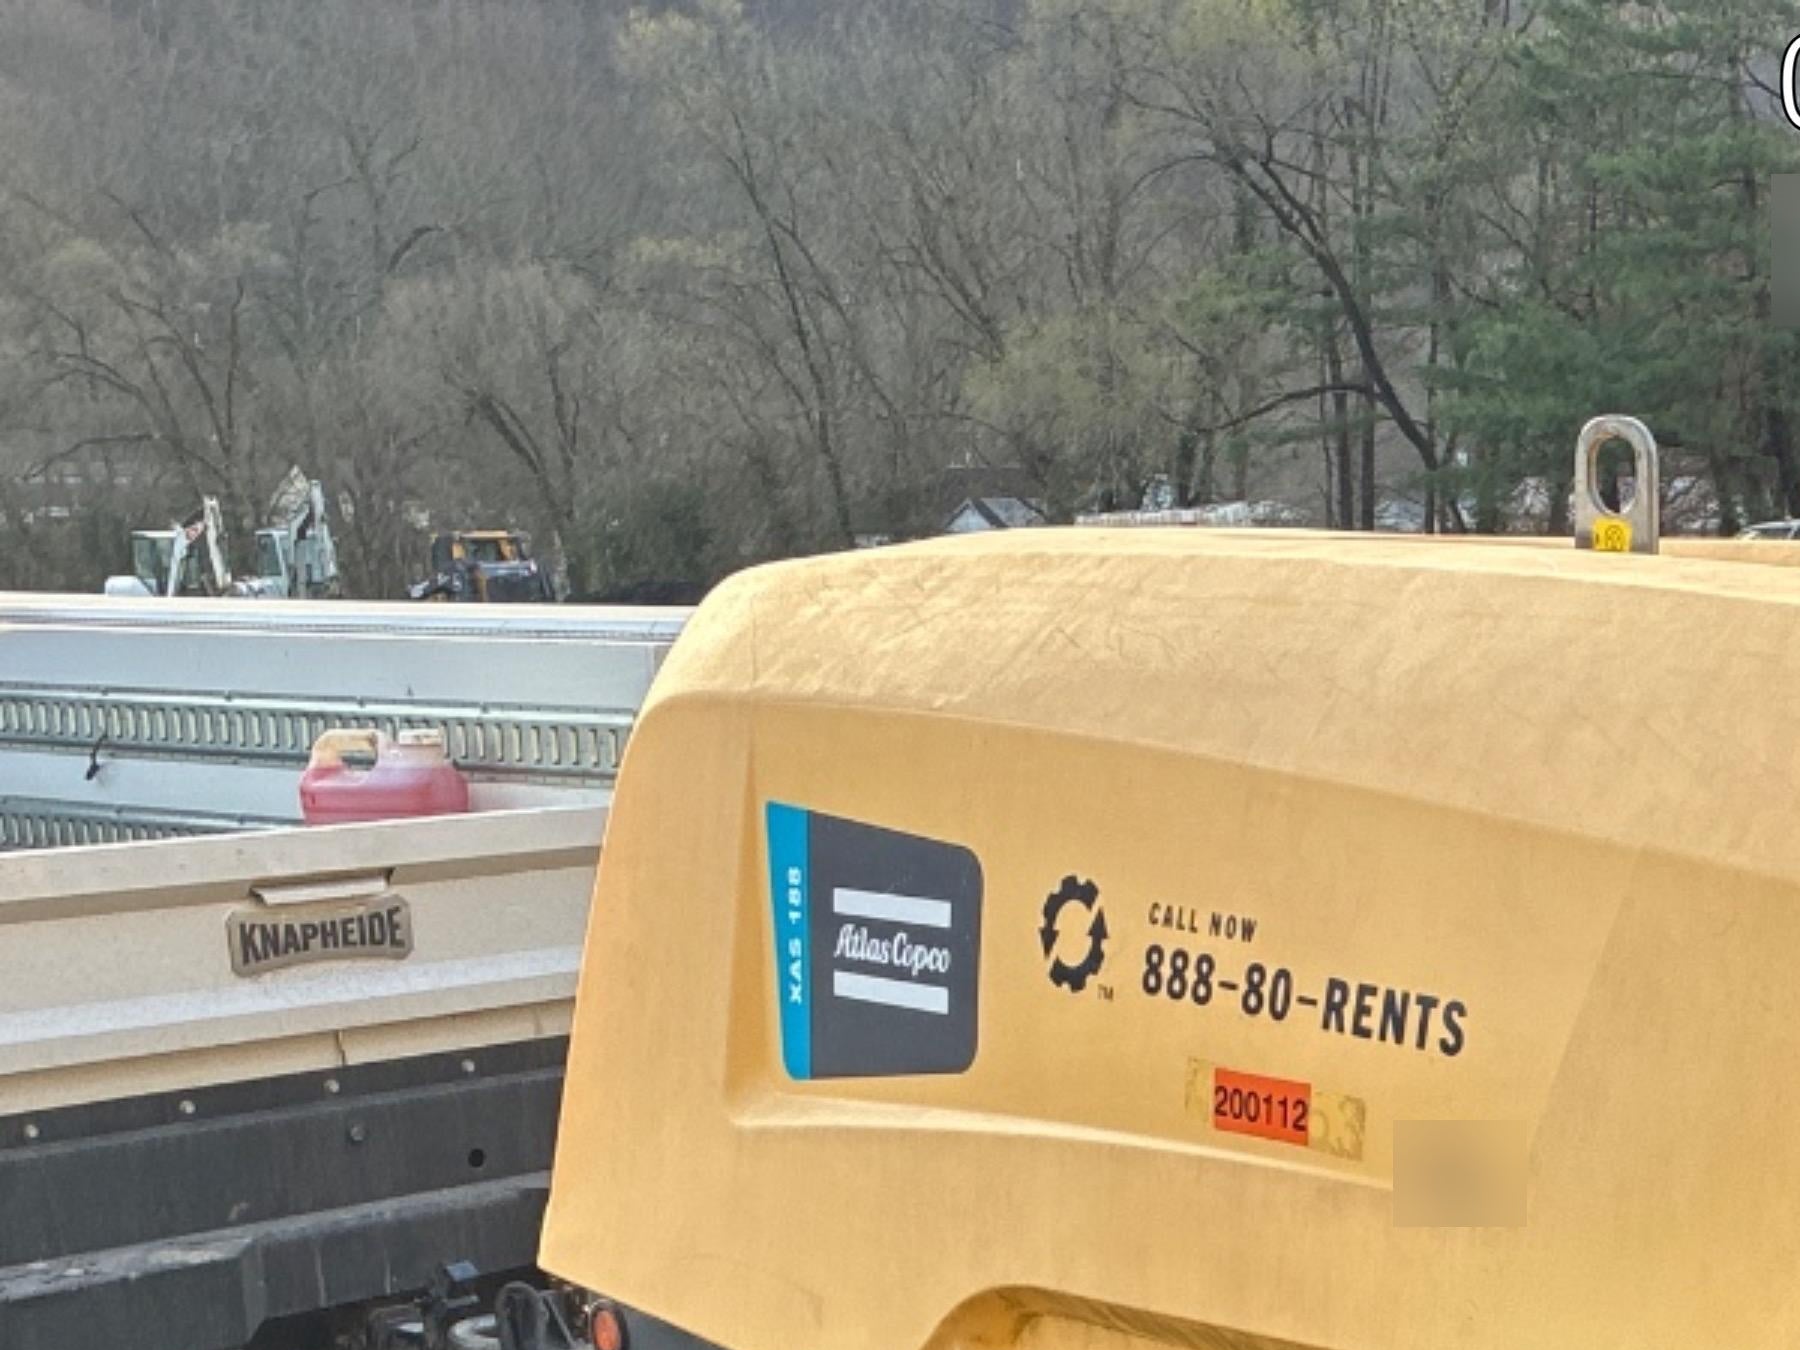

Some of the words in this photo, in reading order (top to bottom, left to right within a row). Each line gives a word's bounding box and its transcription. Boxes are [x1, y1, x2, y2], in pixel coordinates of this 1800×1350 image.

[239, 905, 406, 967] KNAPHEIDE
[832, 922, 890, 965] Atlas
[892, 931, 951, 977] Copco
[1148, 901, 1200, 934] CALL
[1208, 911, 1258, 943] NOW
[786, 937, 804, 1005] XAS
[1141, 944, 1469, 1057] 888-80-RENTS
[1213, 1085, 1309, 1132] 200112
